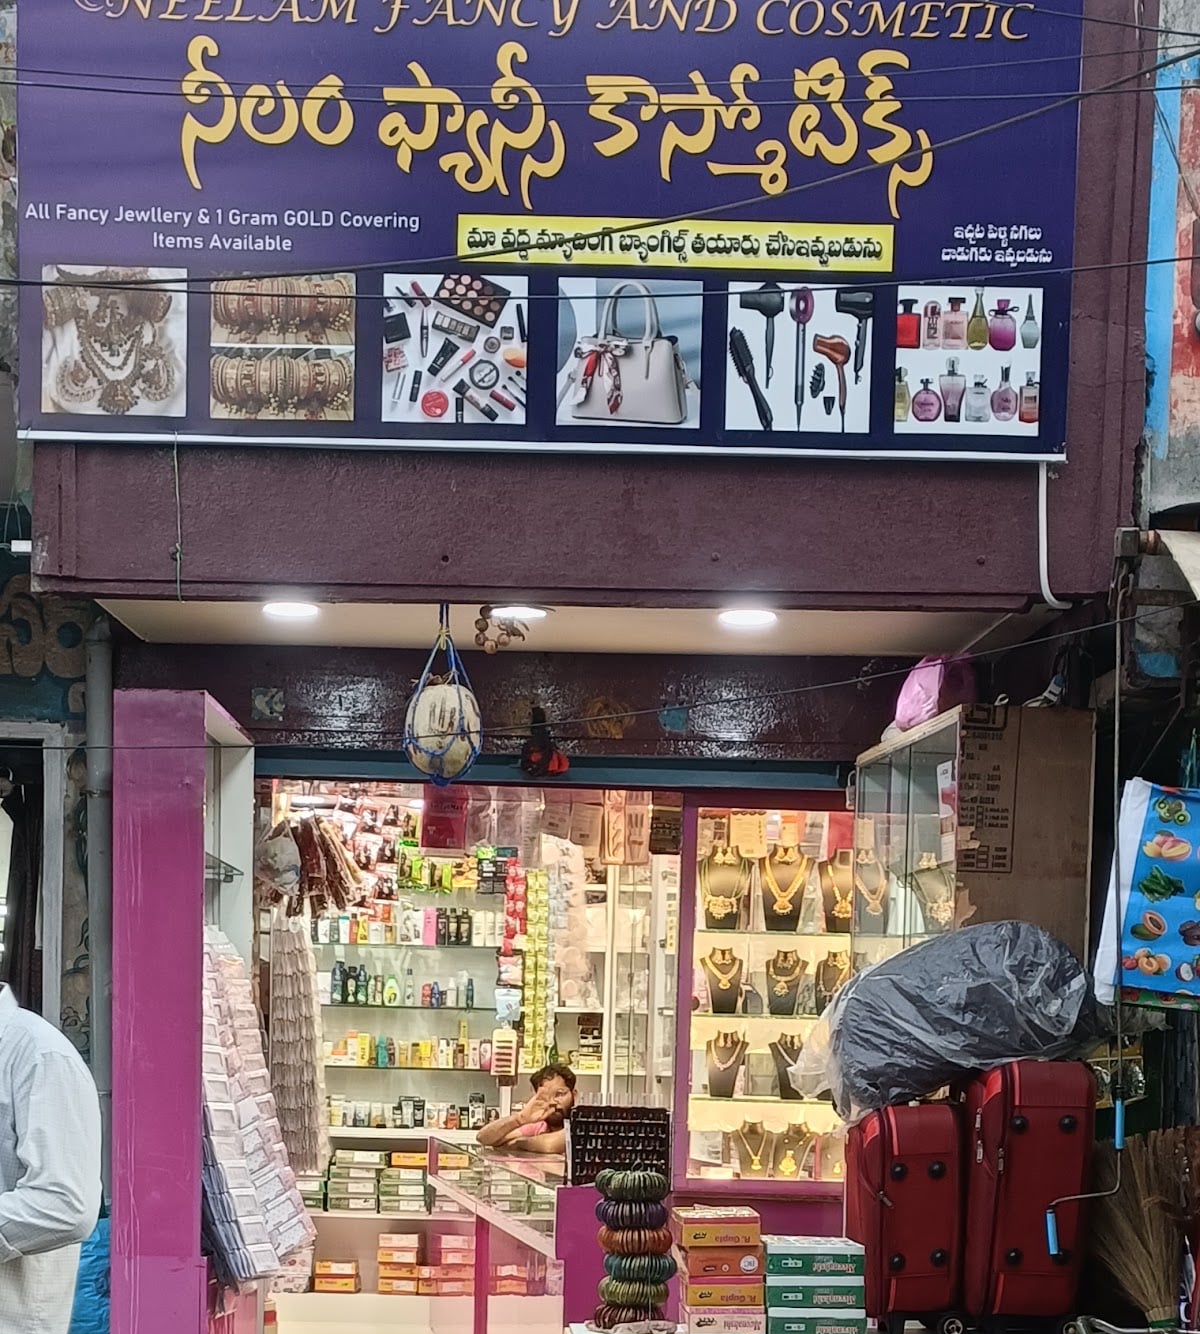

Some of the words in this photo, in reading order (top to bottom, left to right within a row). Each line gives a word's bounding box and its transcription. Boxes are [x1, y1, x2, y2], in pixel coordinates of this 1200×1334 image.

[374, 0, 577, 36] FANCY
[595, 0, 738, 33] AND
[756, 0, 1034, 40] COSMETIC
[180, 35, 355, 190] నీలం
[378, 41, 567, 210] ఫ్యాన్సీ
[25, 203, 50, 219] All
[56, 204, 109, 225] Fancy
[114, 206, 192, 228] Jewllery
[197, 208, 210, 224] &
[215, 208, 223, 224] 1
[228, 209, 278, 226] Gram
[284, 210, 334, 227] GOLD
[340, 211, 420, 232] Covering
[153, 232, 204, 249] Items
[209, 234, 292, 251] Available
[467, 227, 496, 249] మా
[691, 232, 760, 256] తయారు
[1010, 225, 1042, 240] నగలు
